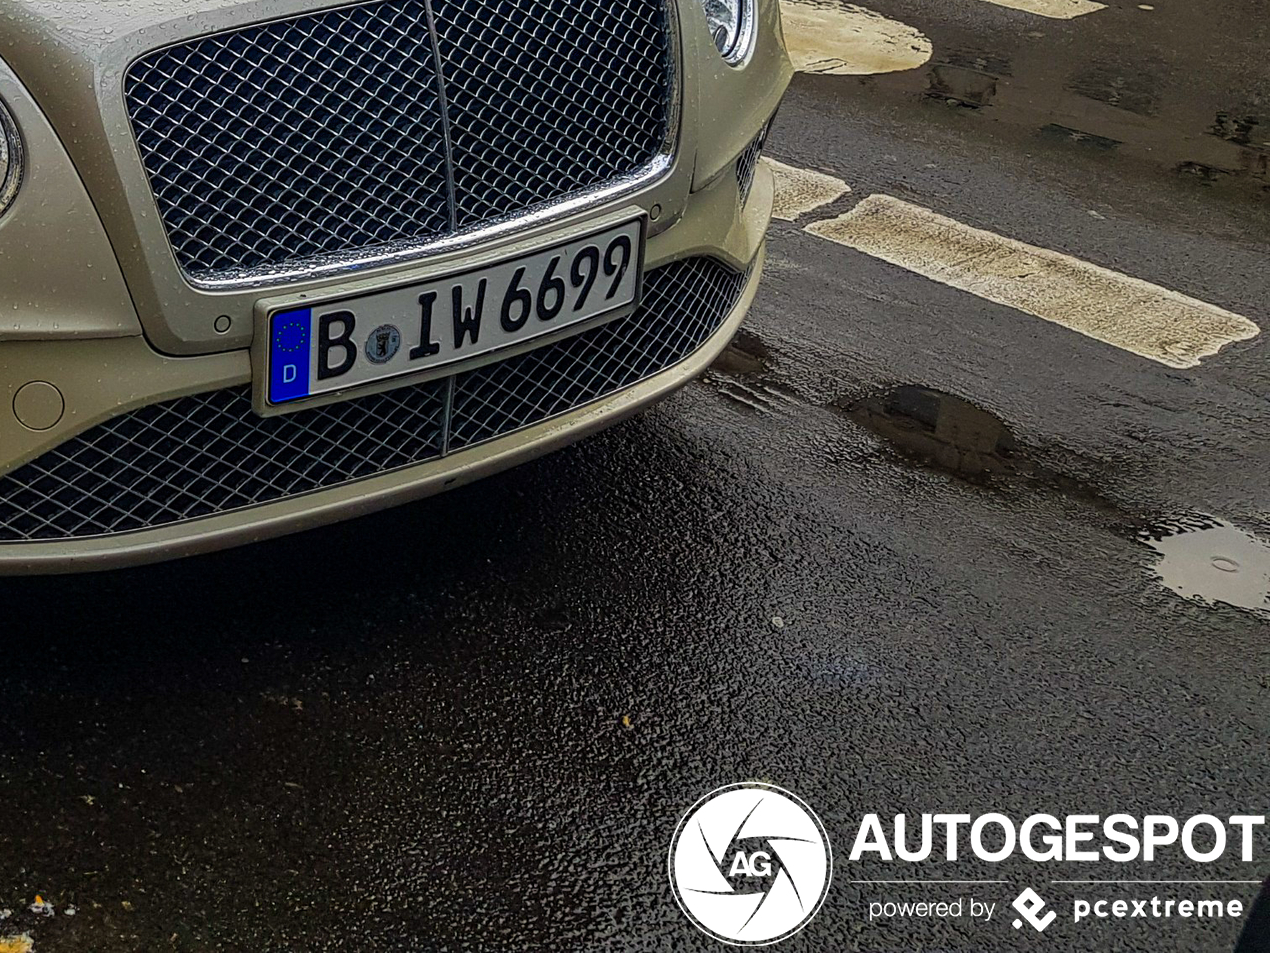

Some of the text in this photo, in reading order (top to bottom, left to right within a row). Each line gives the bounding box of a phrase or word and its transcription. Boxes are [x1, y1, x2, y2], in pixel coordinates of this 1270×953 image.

[283, 364, 297, 383] D
[317, 310, 358, 381] B
[408, 278, 488, 361] IW
[499, 234, 632, 333] 6699
